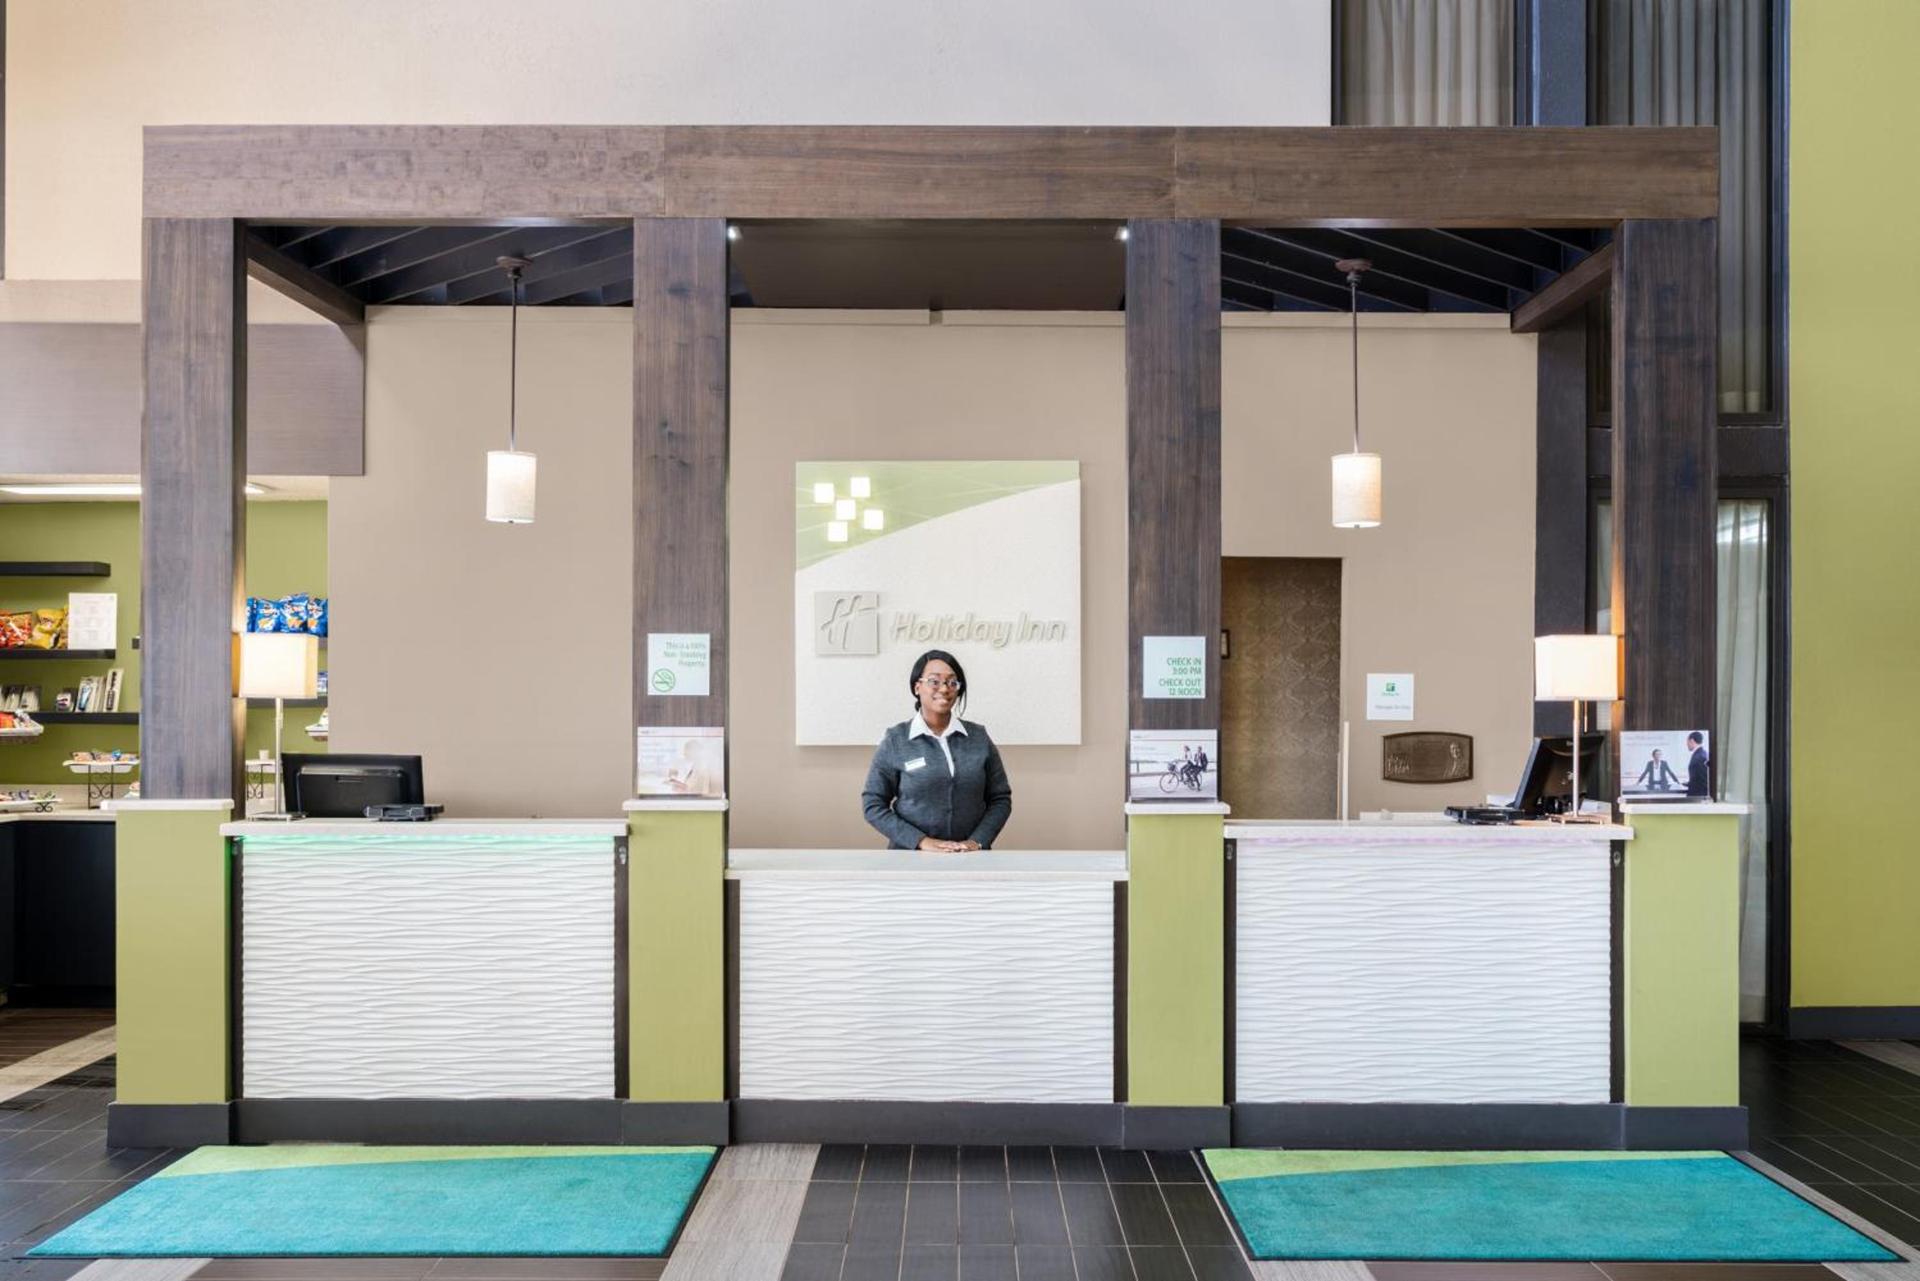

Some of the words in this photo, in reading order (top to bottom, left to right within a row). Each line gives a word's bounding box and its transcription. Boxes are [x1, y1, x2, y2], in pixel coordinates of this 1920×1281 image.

[892, 612, 1013, 648] Holiday
[1016, 611, 1067, 643] Inn
[1166, 656, 1192, 666] CHECK
[1193, 656, 1202, 666] IN
[1189, 666, 1202, 675] PM
[1159, 678, 1184, 687] CHECK
[1185, 678, 1202, 687] OUT
[1169, 687, 1176, 696] 12
[1177, 687, 1202, 696] NOON
